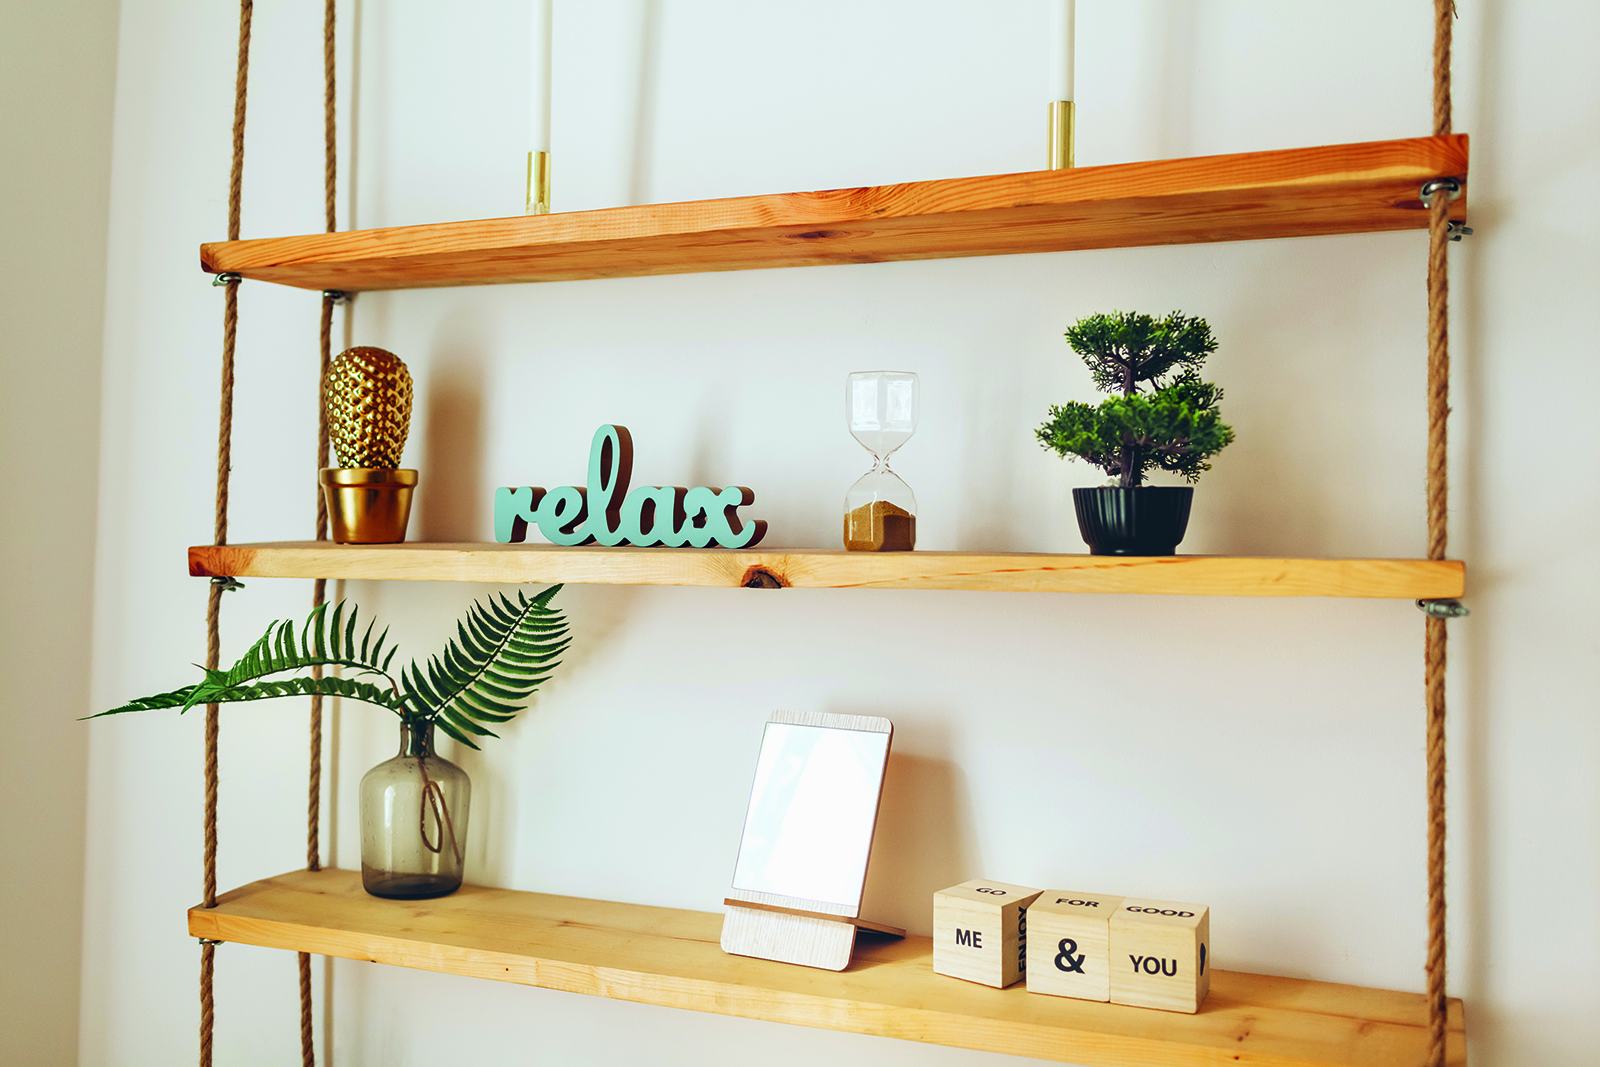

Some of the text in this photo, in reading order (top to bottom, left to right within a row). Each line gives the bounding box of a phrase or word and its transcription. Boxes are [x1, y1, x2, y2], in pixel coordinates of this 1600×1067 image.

[494, 424, 768, 549] relax
[975, 887, 1195, 918] GO FOR GOOD
[955, 928, 1178, 977] ME & YOU
[1018, 906, 1027, 973] ENJOY
